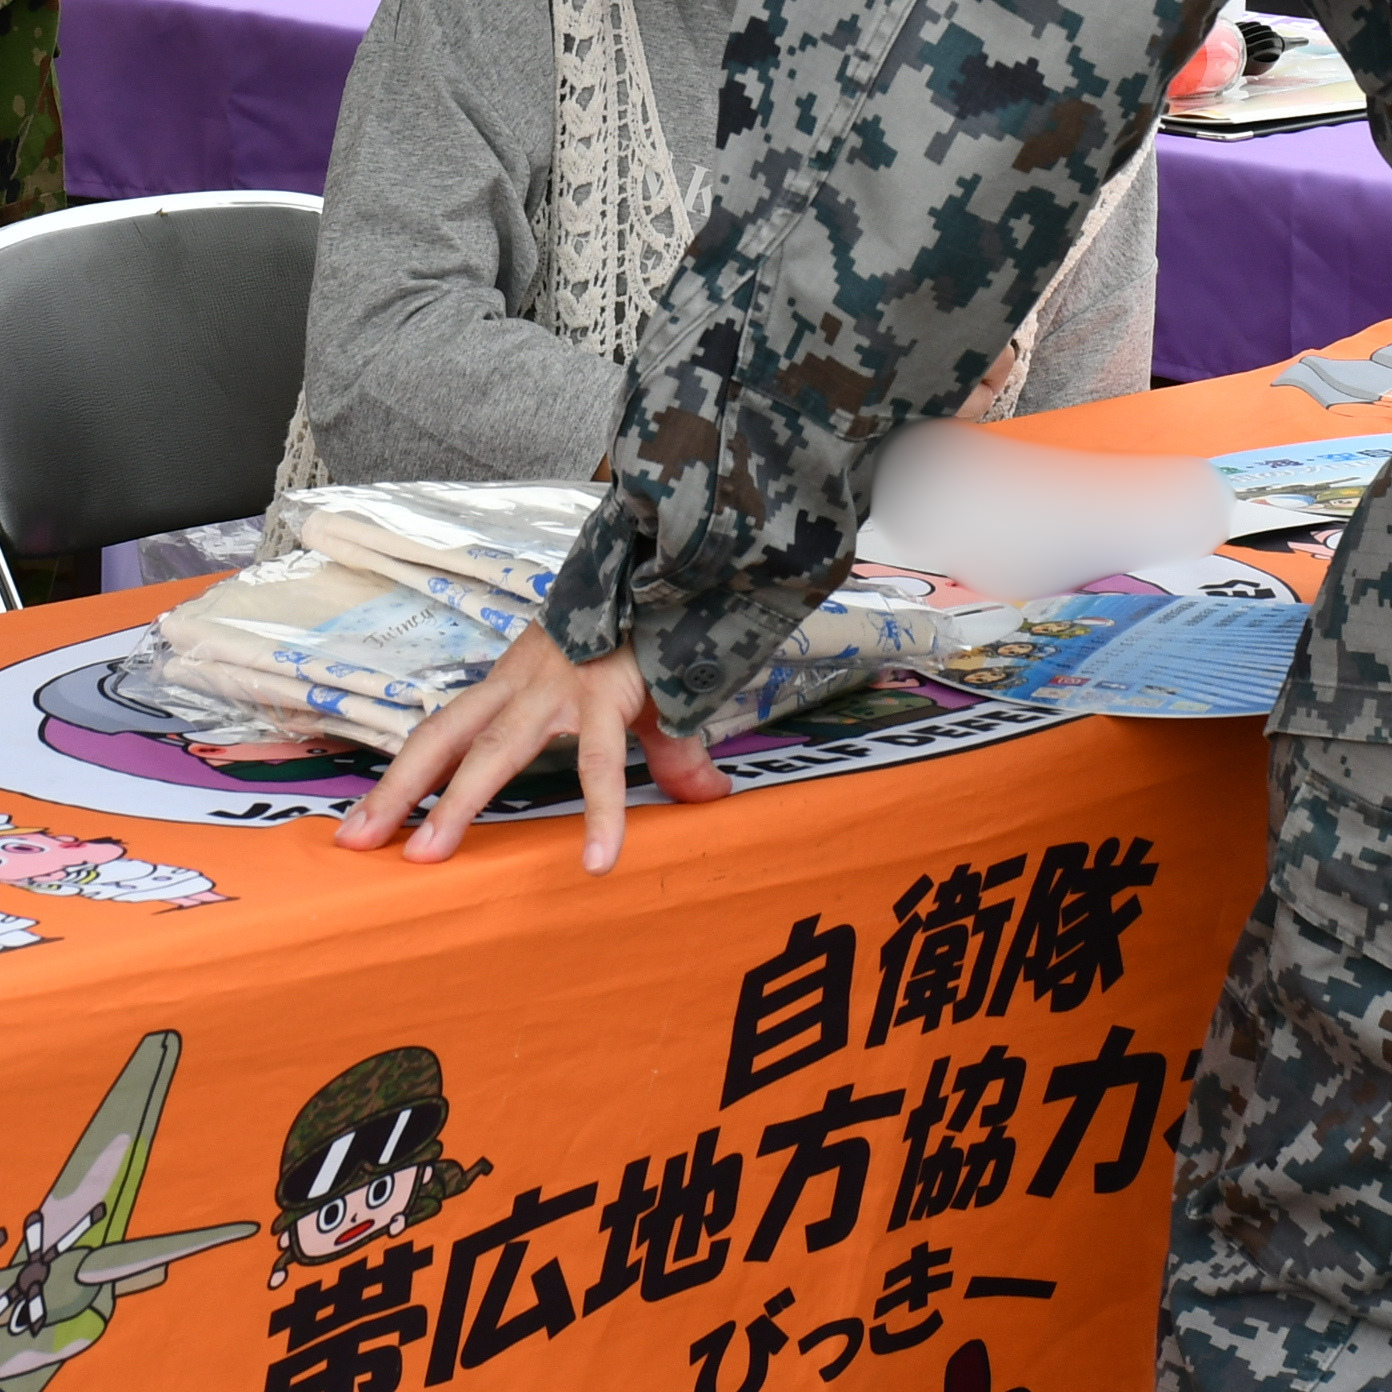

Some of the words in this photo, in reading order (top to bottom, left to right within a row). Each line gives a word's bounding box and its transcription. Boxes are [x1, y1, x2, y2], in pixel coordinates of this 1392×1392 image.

[716, 744, 873, 779] SELF
[720, 836, 1160, 1112] 自衛隊
[265, 1025, 1204, 1392] 帯広地方協力
